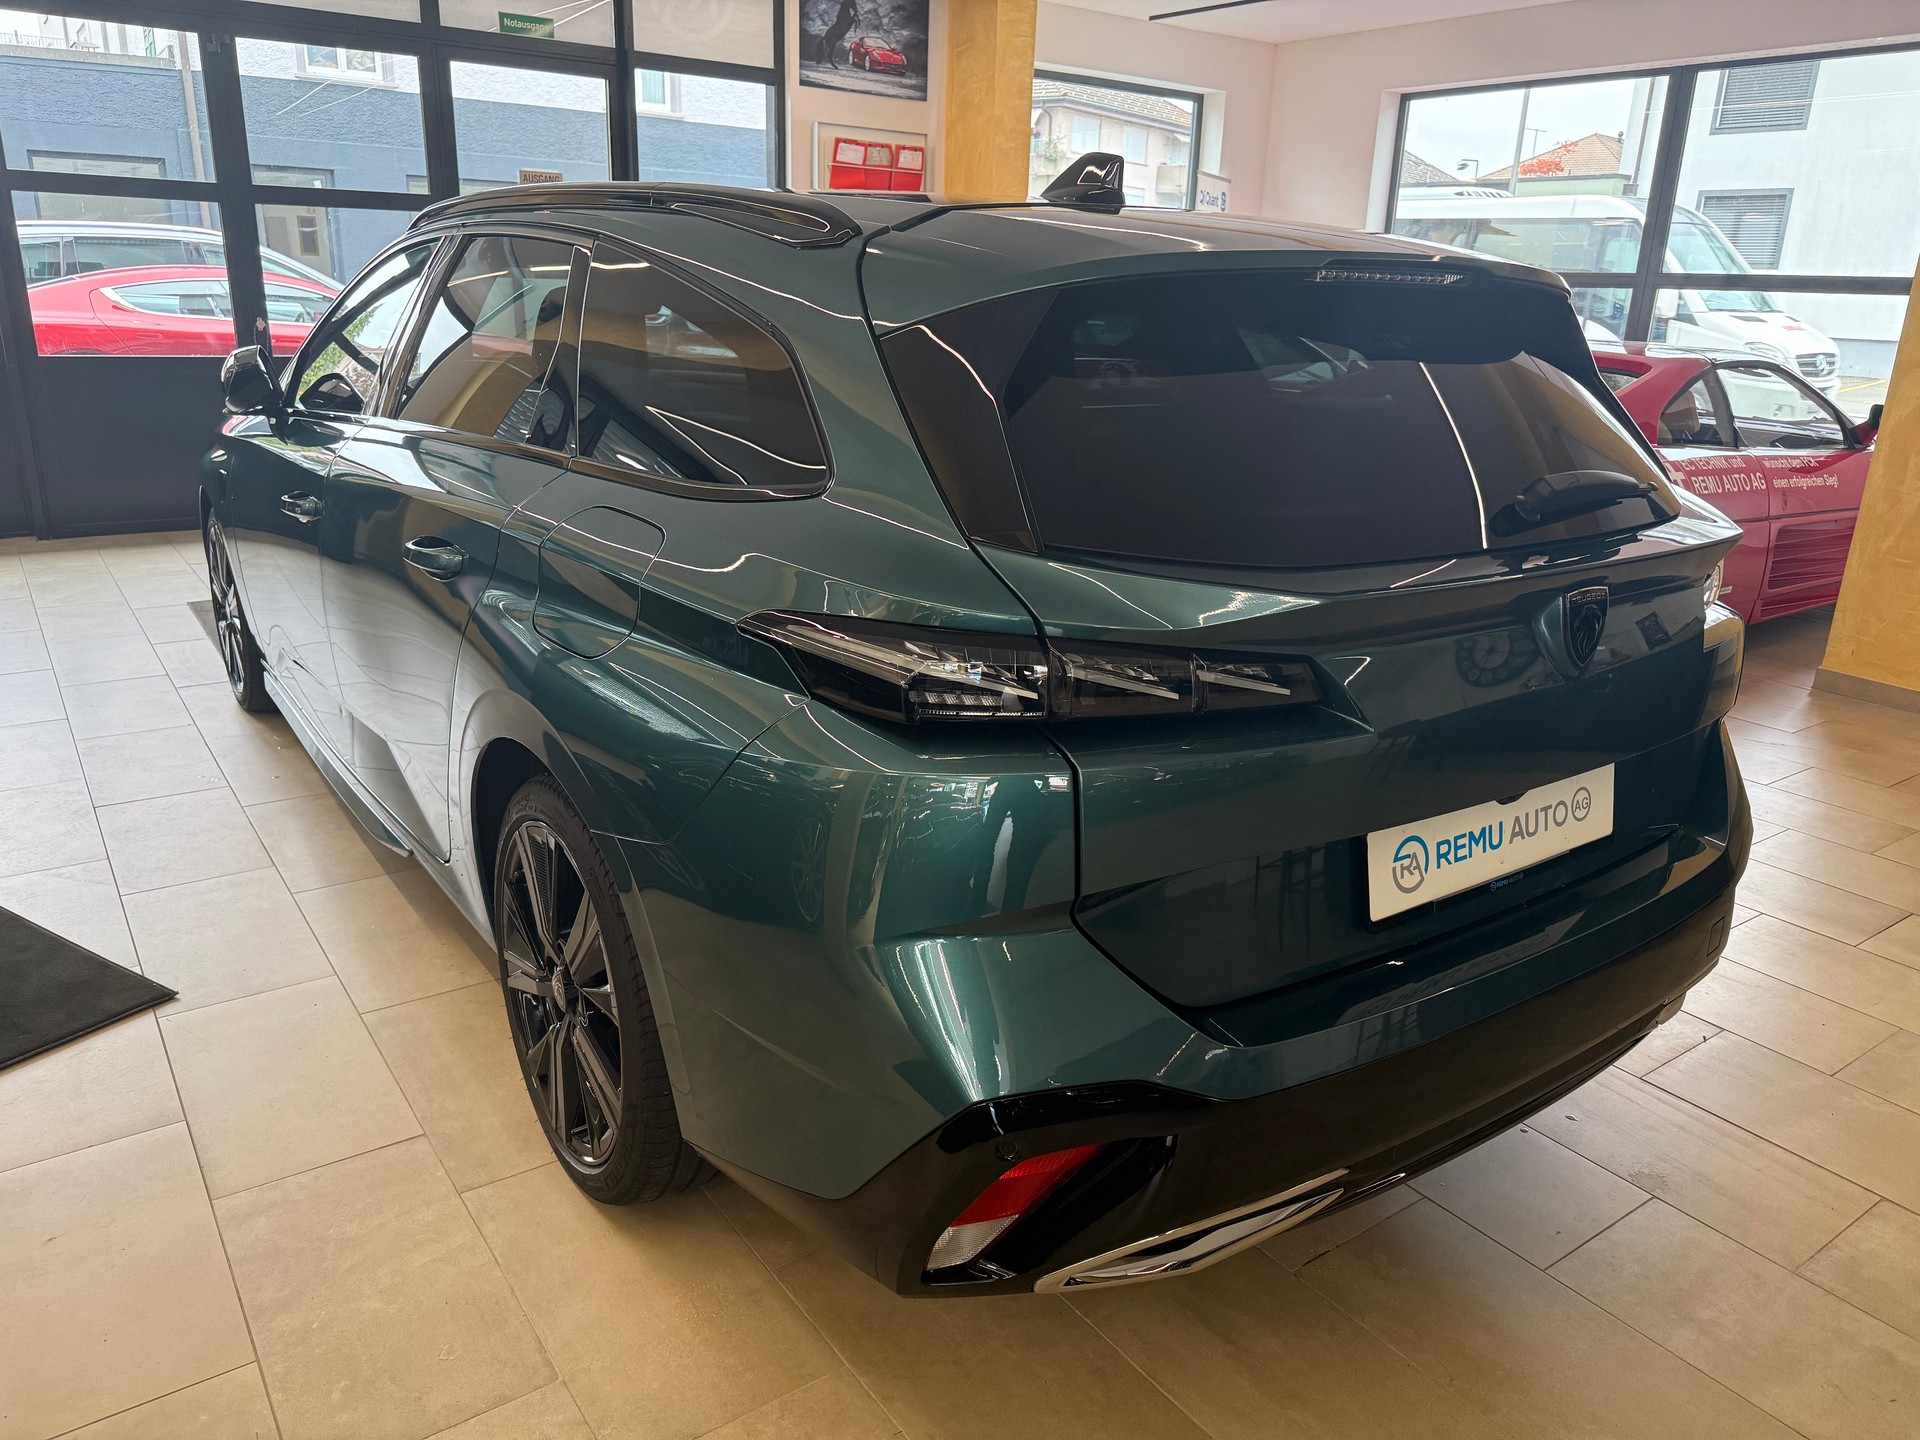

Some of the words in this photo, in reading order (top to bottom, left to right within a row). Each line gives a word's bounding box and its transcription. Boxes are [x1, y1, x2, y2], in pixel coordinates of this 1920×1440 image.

[503, 17, 549, 33] Notausgang
[523, 172, 560, 183] AUSGANG
[1694, 457, 1731, 470] TECHNIK
[1728, 456, 1746, 468] und
[1788, 456, 1805, 468] dem
[1690, 474, 1723, 495] REMU
[1722, 473, 1750, 493] AUTO
[1749, 472, 1767, 490] AG
[1772, 476, 1790, 489] einen
[1789, 475, 1825, 490] erfolgreichen
[1823, 473, 1839, 489] Sieg!
[1571, 592, 1606, 604] PEUGEOT
[1435, 821, 1504, 870] REMU
[1508, 800, 1569, 844] AUTO
[1574, 796, 1590, 813] AG
